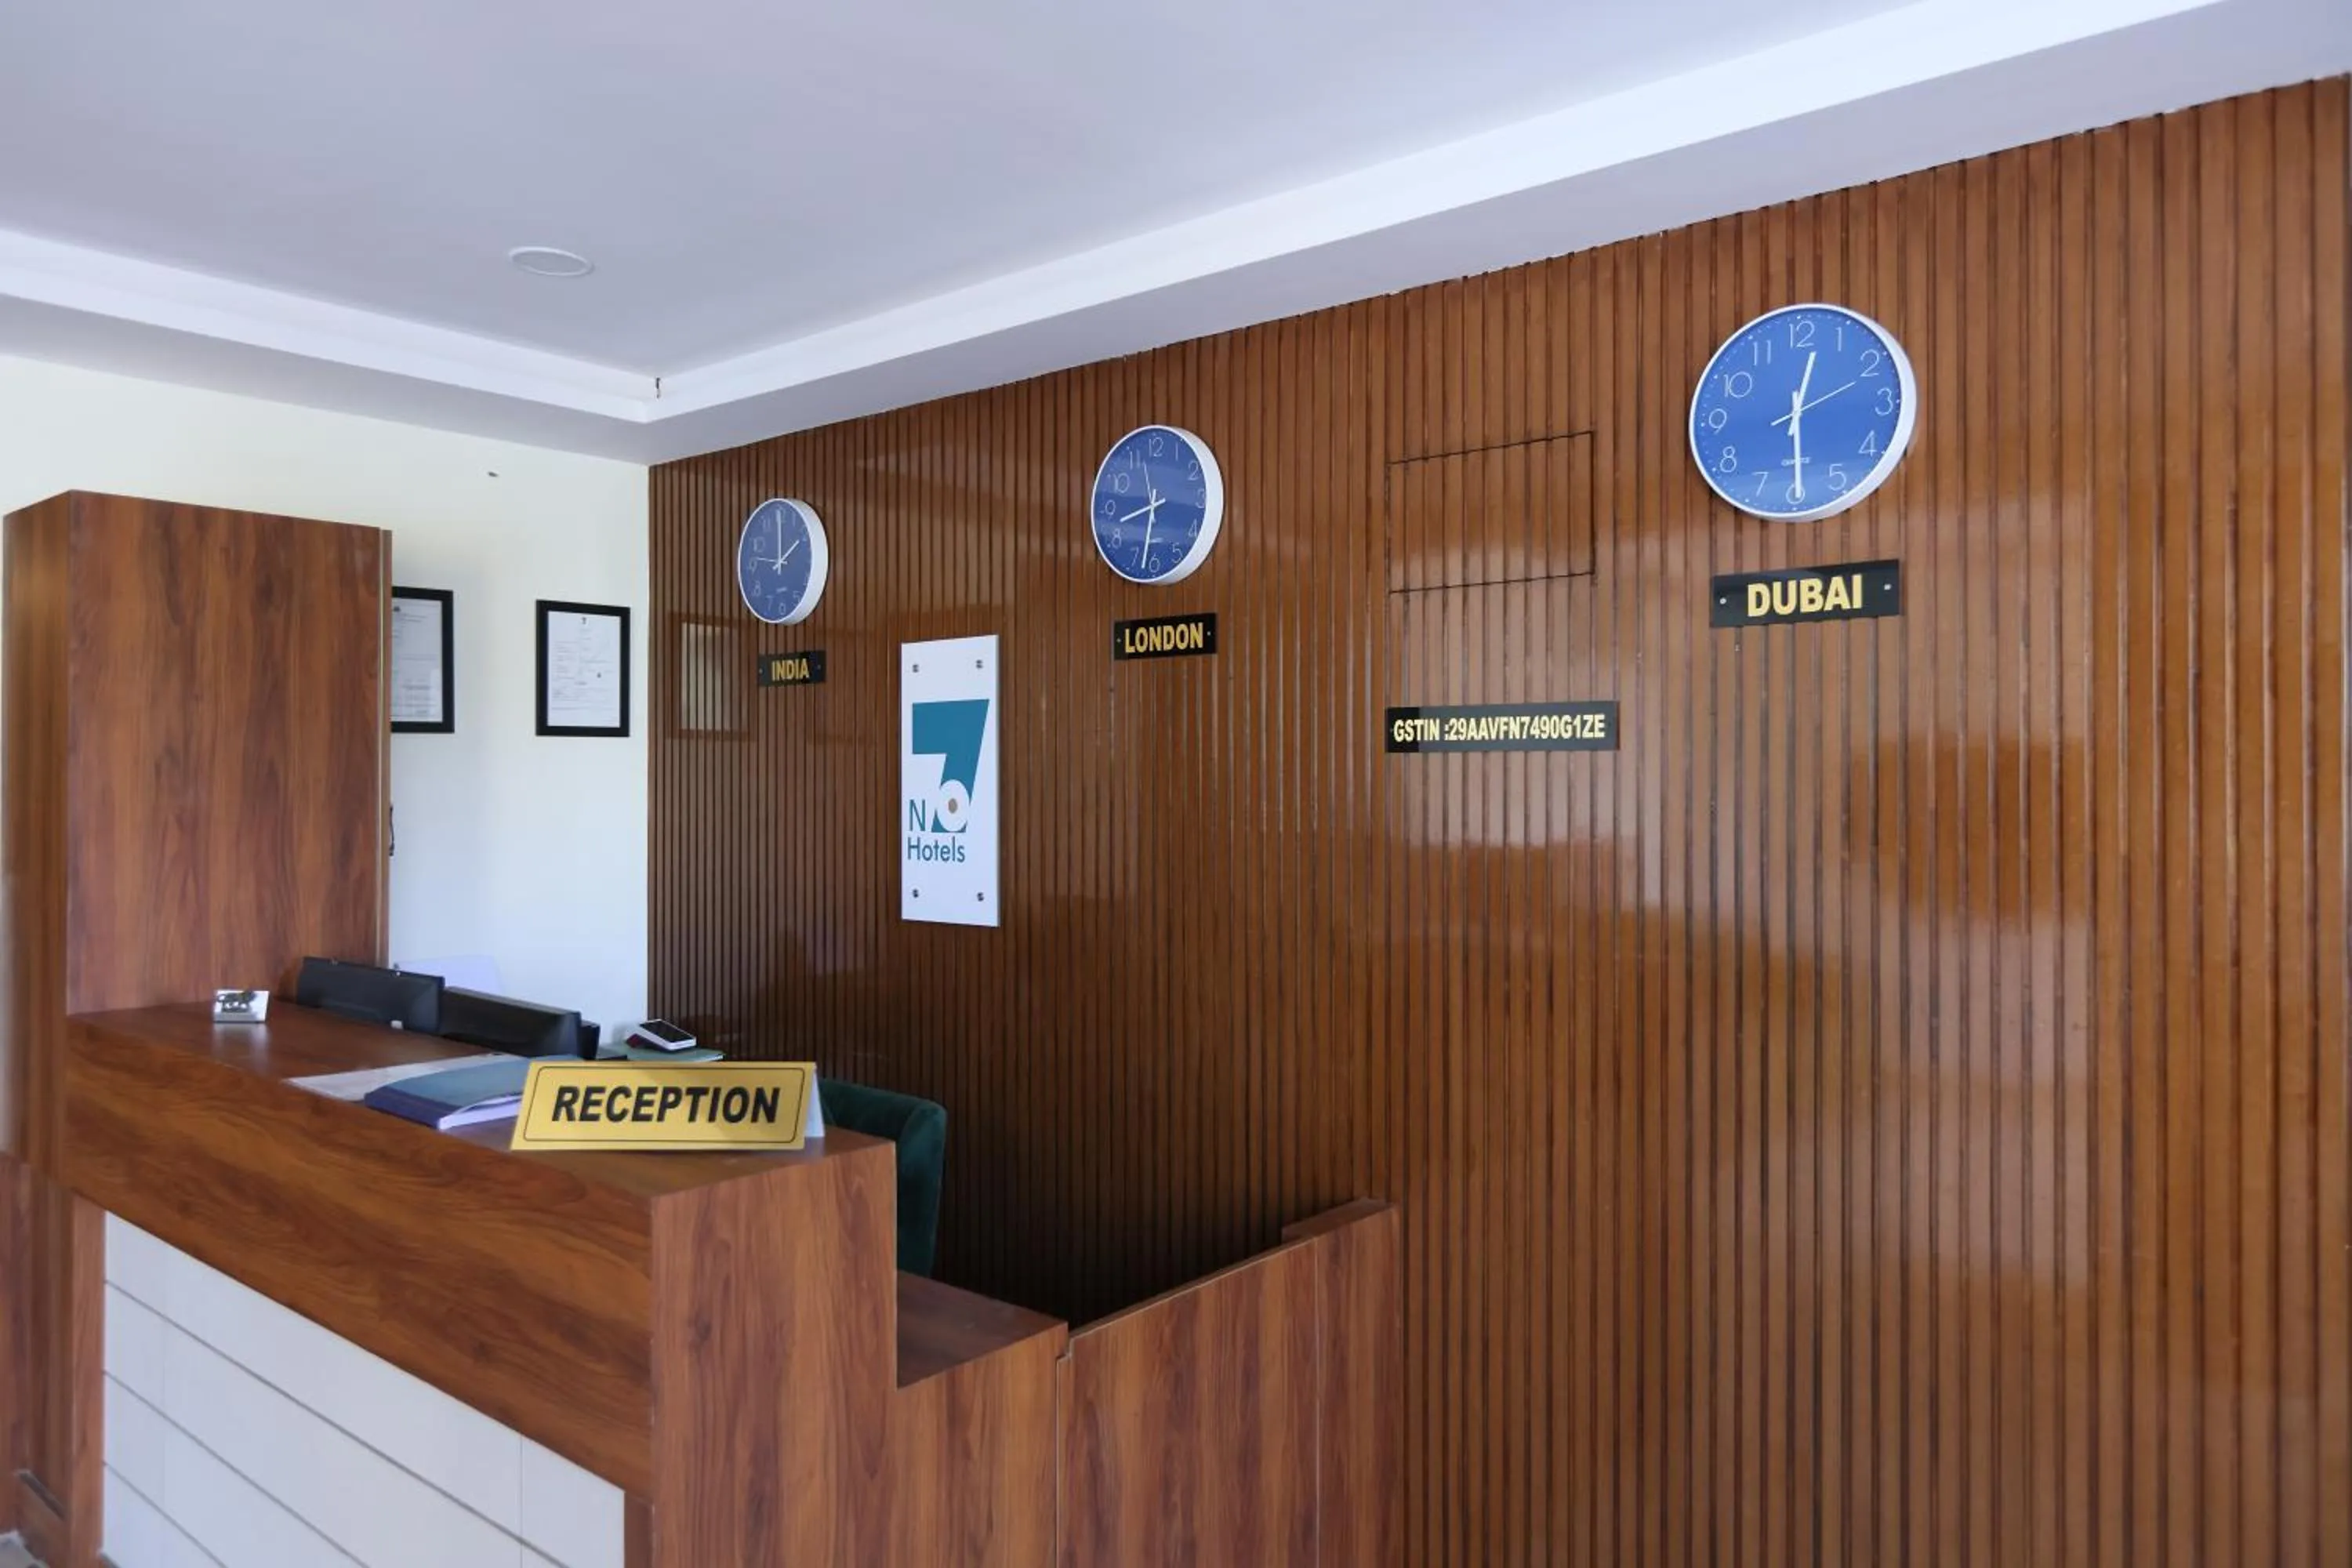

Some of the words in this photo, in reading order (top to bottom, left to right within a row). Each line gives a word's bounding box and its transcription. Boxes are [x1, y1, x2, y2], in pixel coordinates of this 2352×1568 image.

[1789, 320, 1815, 348] 12
[1836, 326, 1842, 351] 1
[1752, 339, 1772, 366] 11
[1860, 349, 1879, 377] 2
[1723, 371, 1753, 398] 10
[1875, 387, 1893, 416] 3
[1708, 408, 1727, 434] 9
[1149, 437, 1164, 457] 12
[1858, 430, 1878, 457] 4
[1188, 460, 1201, 481] 2
[1719, 446, 1737, 474] 8
[1754, 471, 1769, 496] 7
[1828, 463, 1847, 492] 5
[1111, 528, 1122, 549] 8
[1188, 518, 1199, 538] 4
[1149, 553, 1161, 573] 6
[1171, 542, 1183, 564] 5
[1748, 574, 1863, 618] DUBAI
[1125, 622, 1204, 654] LONDON
[771, 659, 810, 681] INDIA
[1393, 717, 1440, 742] GSTIN
[1444, 713, 1606, 742] :29AAVFN7490G1ZE
[907, 836, 966, 862] Hotels
[551, 1085, 782, 1124] RECEPTION
